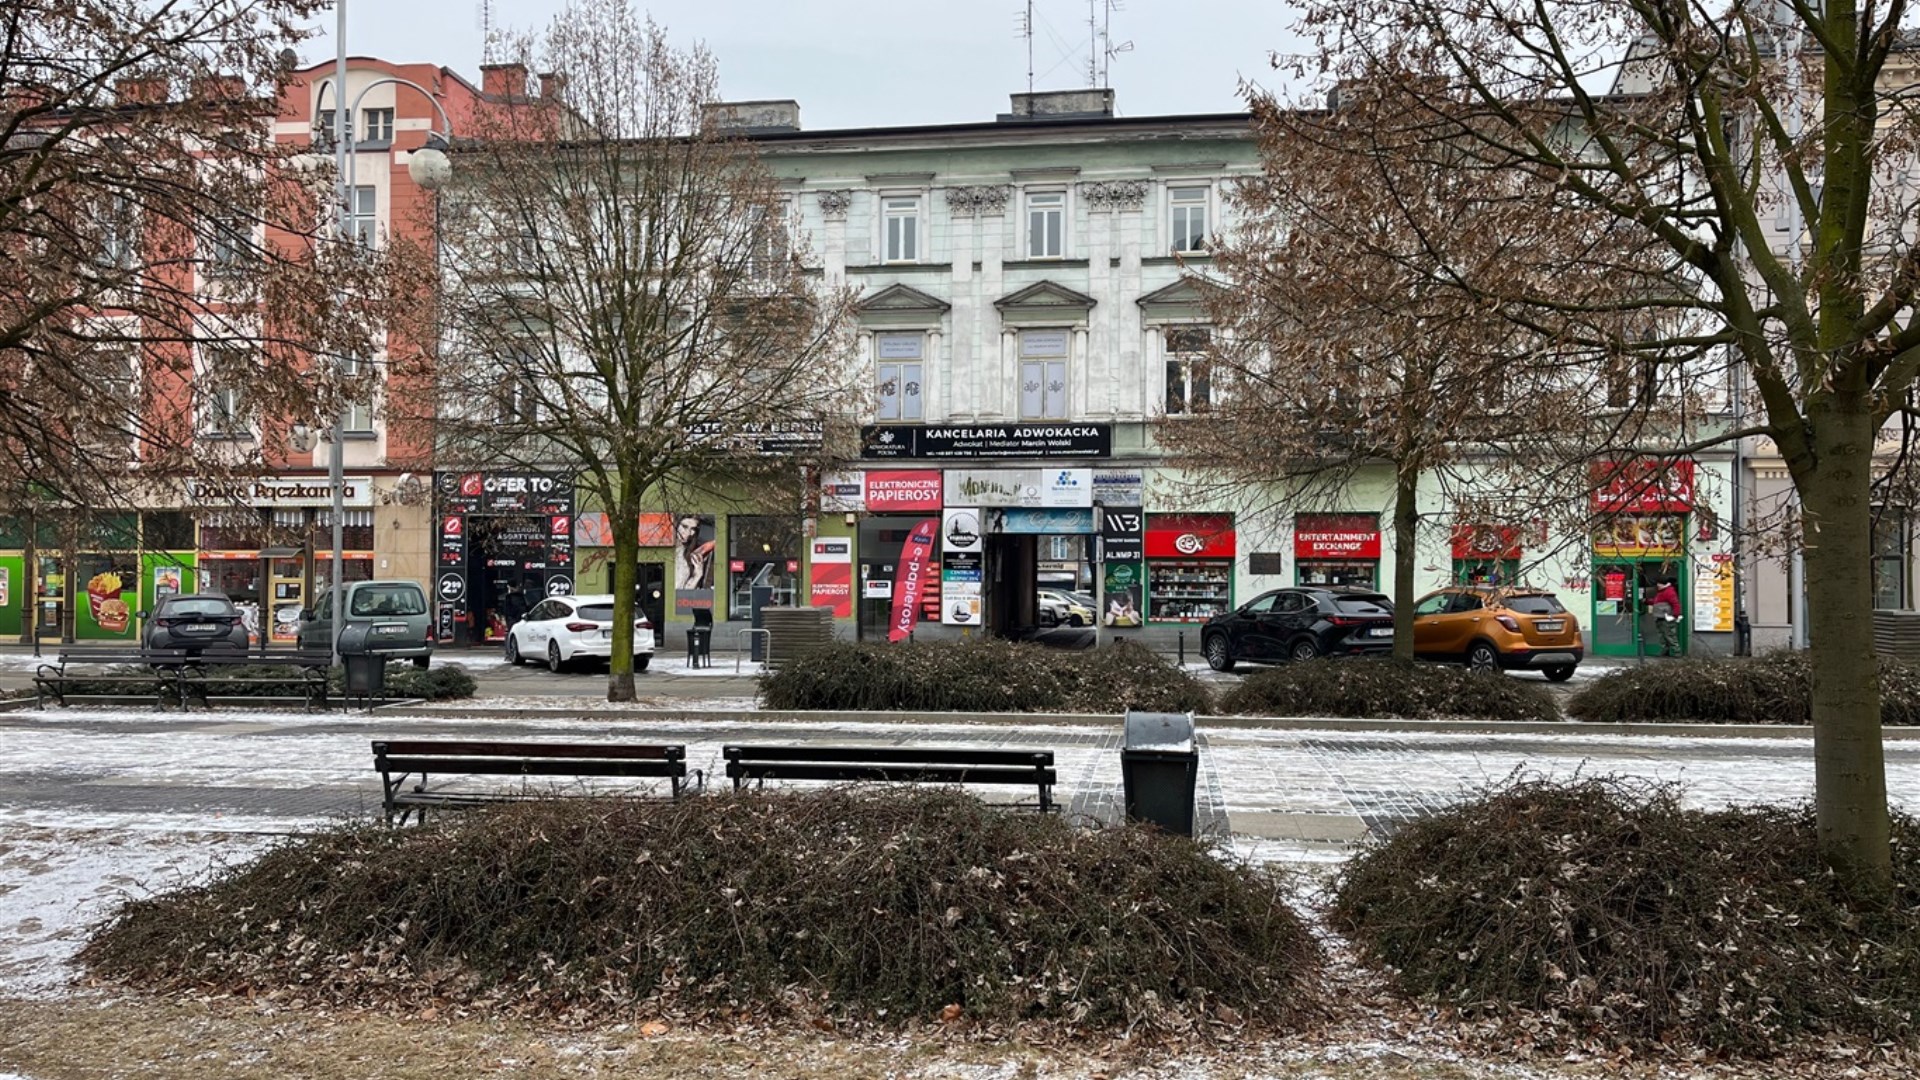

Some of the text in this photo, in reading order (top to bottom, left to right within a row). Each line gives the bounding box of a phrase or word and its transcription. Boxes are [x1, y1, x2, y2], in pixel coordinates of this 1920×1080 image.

[925, 427, 1099, 439] KANCELARIA ADWOKACKA
[869, 480, 940, 490] ELEKTRONICZNE
[869, 489, 940, 501] PAPIEROSY
[1299, 533, 1377, 542] ENTERTAINMENT
[1313, 542, 1362, 551] EXCHANGE
[897, 547, 923, 633] e-papierosy
